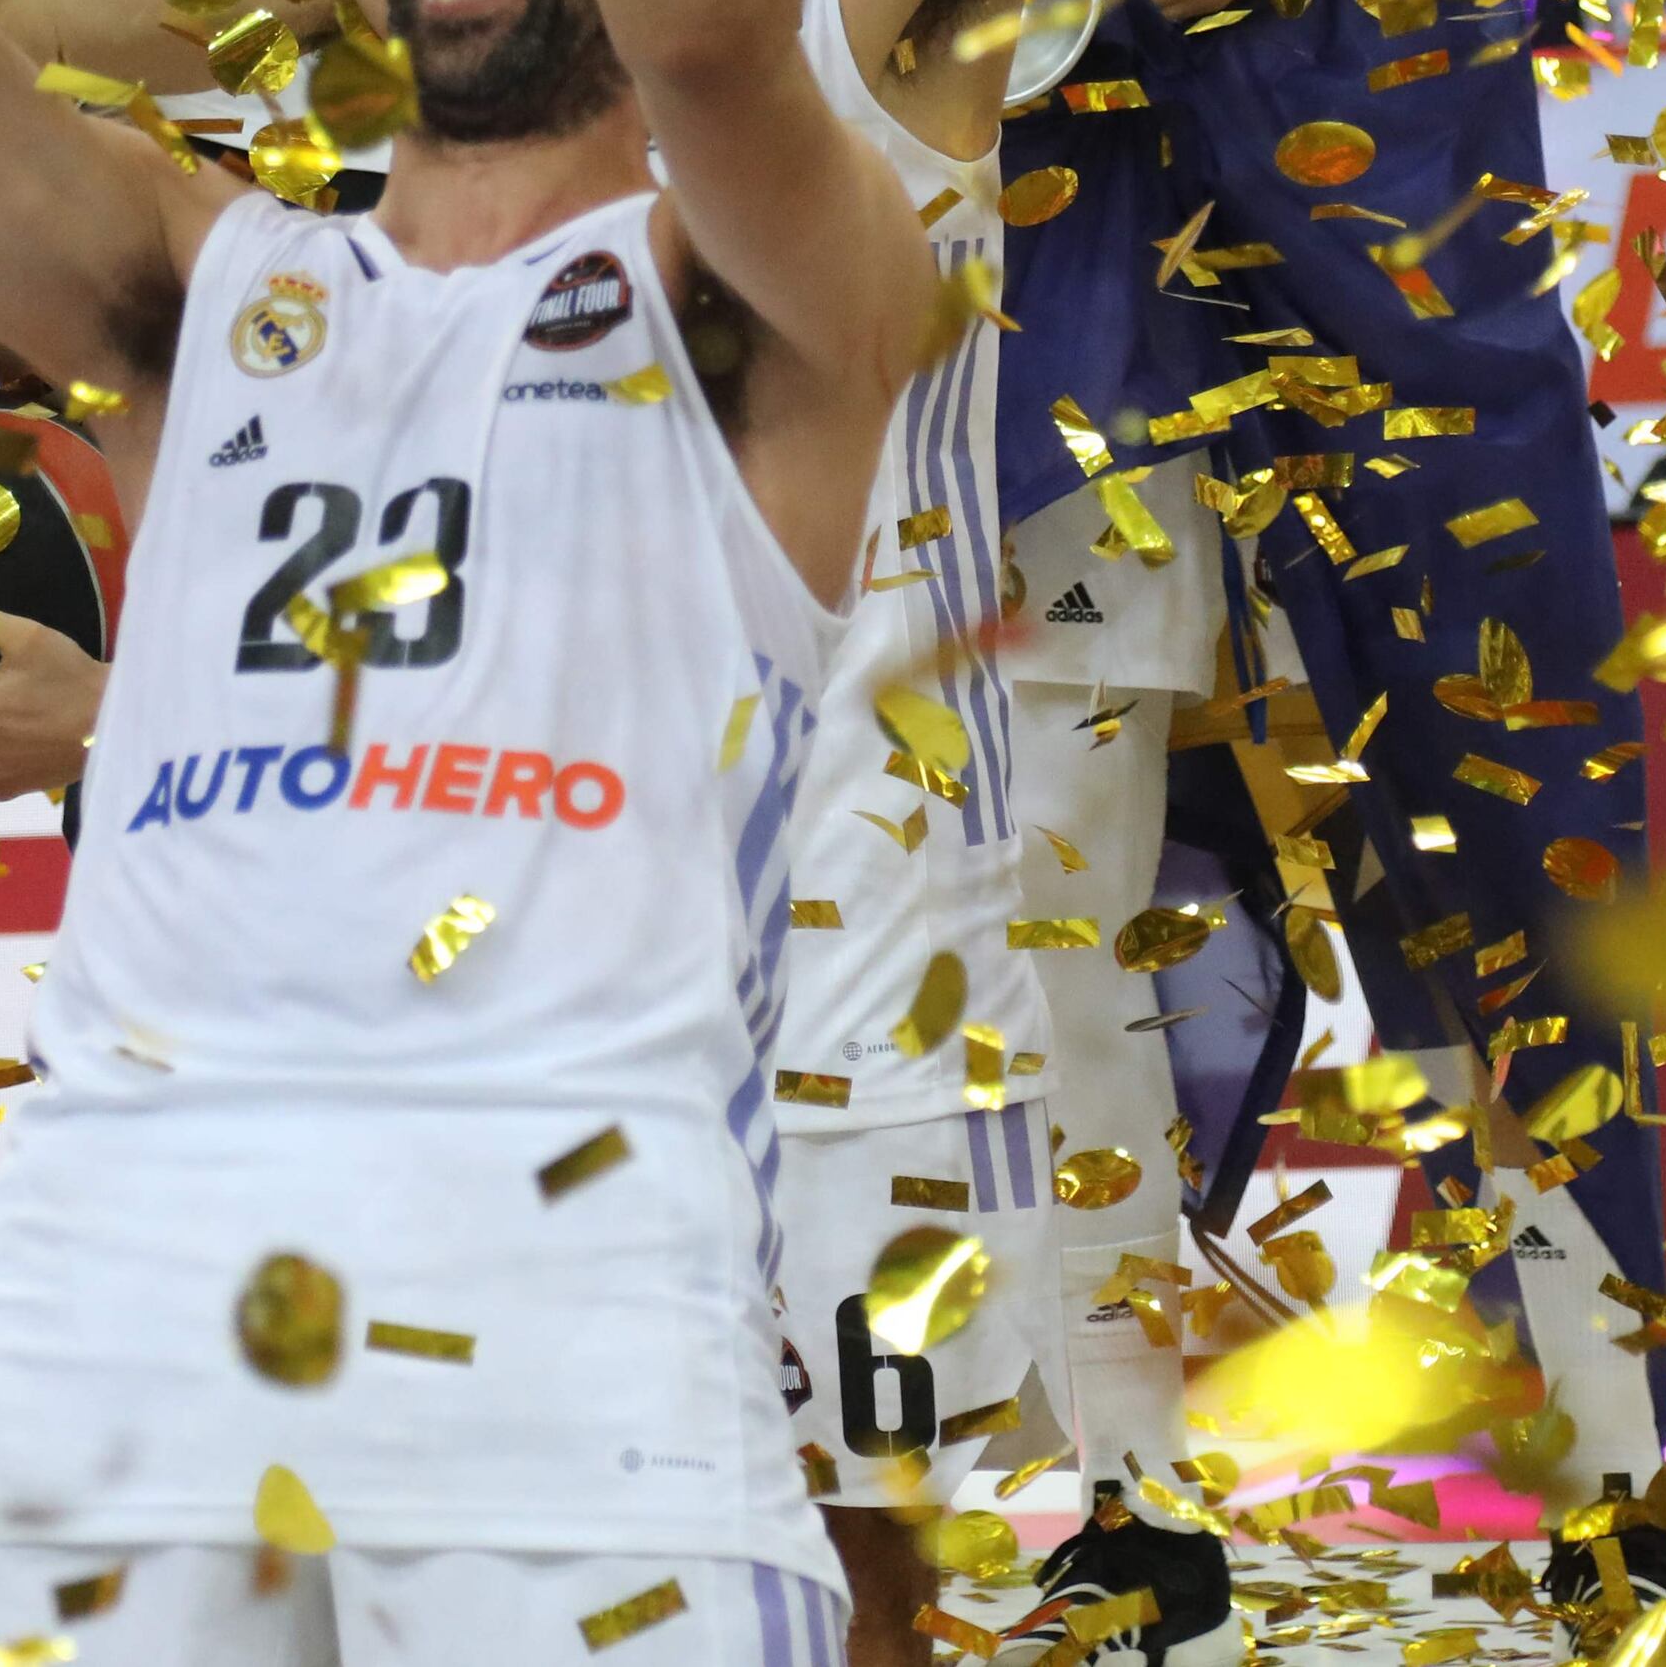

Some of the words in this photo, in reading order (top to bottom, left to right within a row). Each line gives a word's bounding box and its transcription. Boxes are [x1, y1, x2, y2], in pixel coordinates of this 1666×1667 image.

[531, 287, 576, 325] FINAL
[577, 278, 620, 314] FOUR
[503, 377, 608, 403] onetea
[209, 445, 269, 468] adidas
[235, 477, 471, 673] 23
[1045, 609, 1103, 623] adidas
[125, 741, 625, 834] AUTOHERO
[835, 1293, 936, 1458] 6
